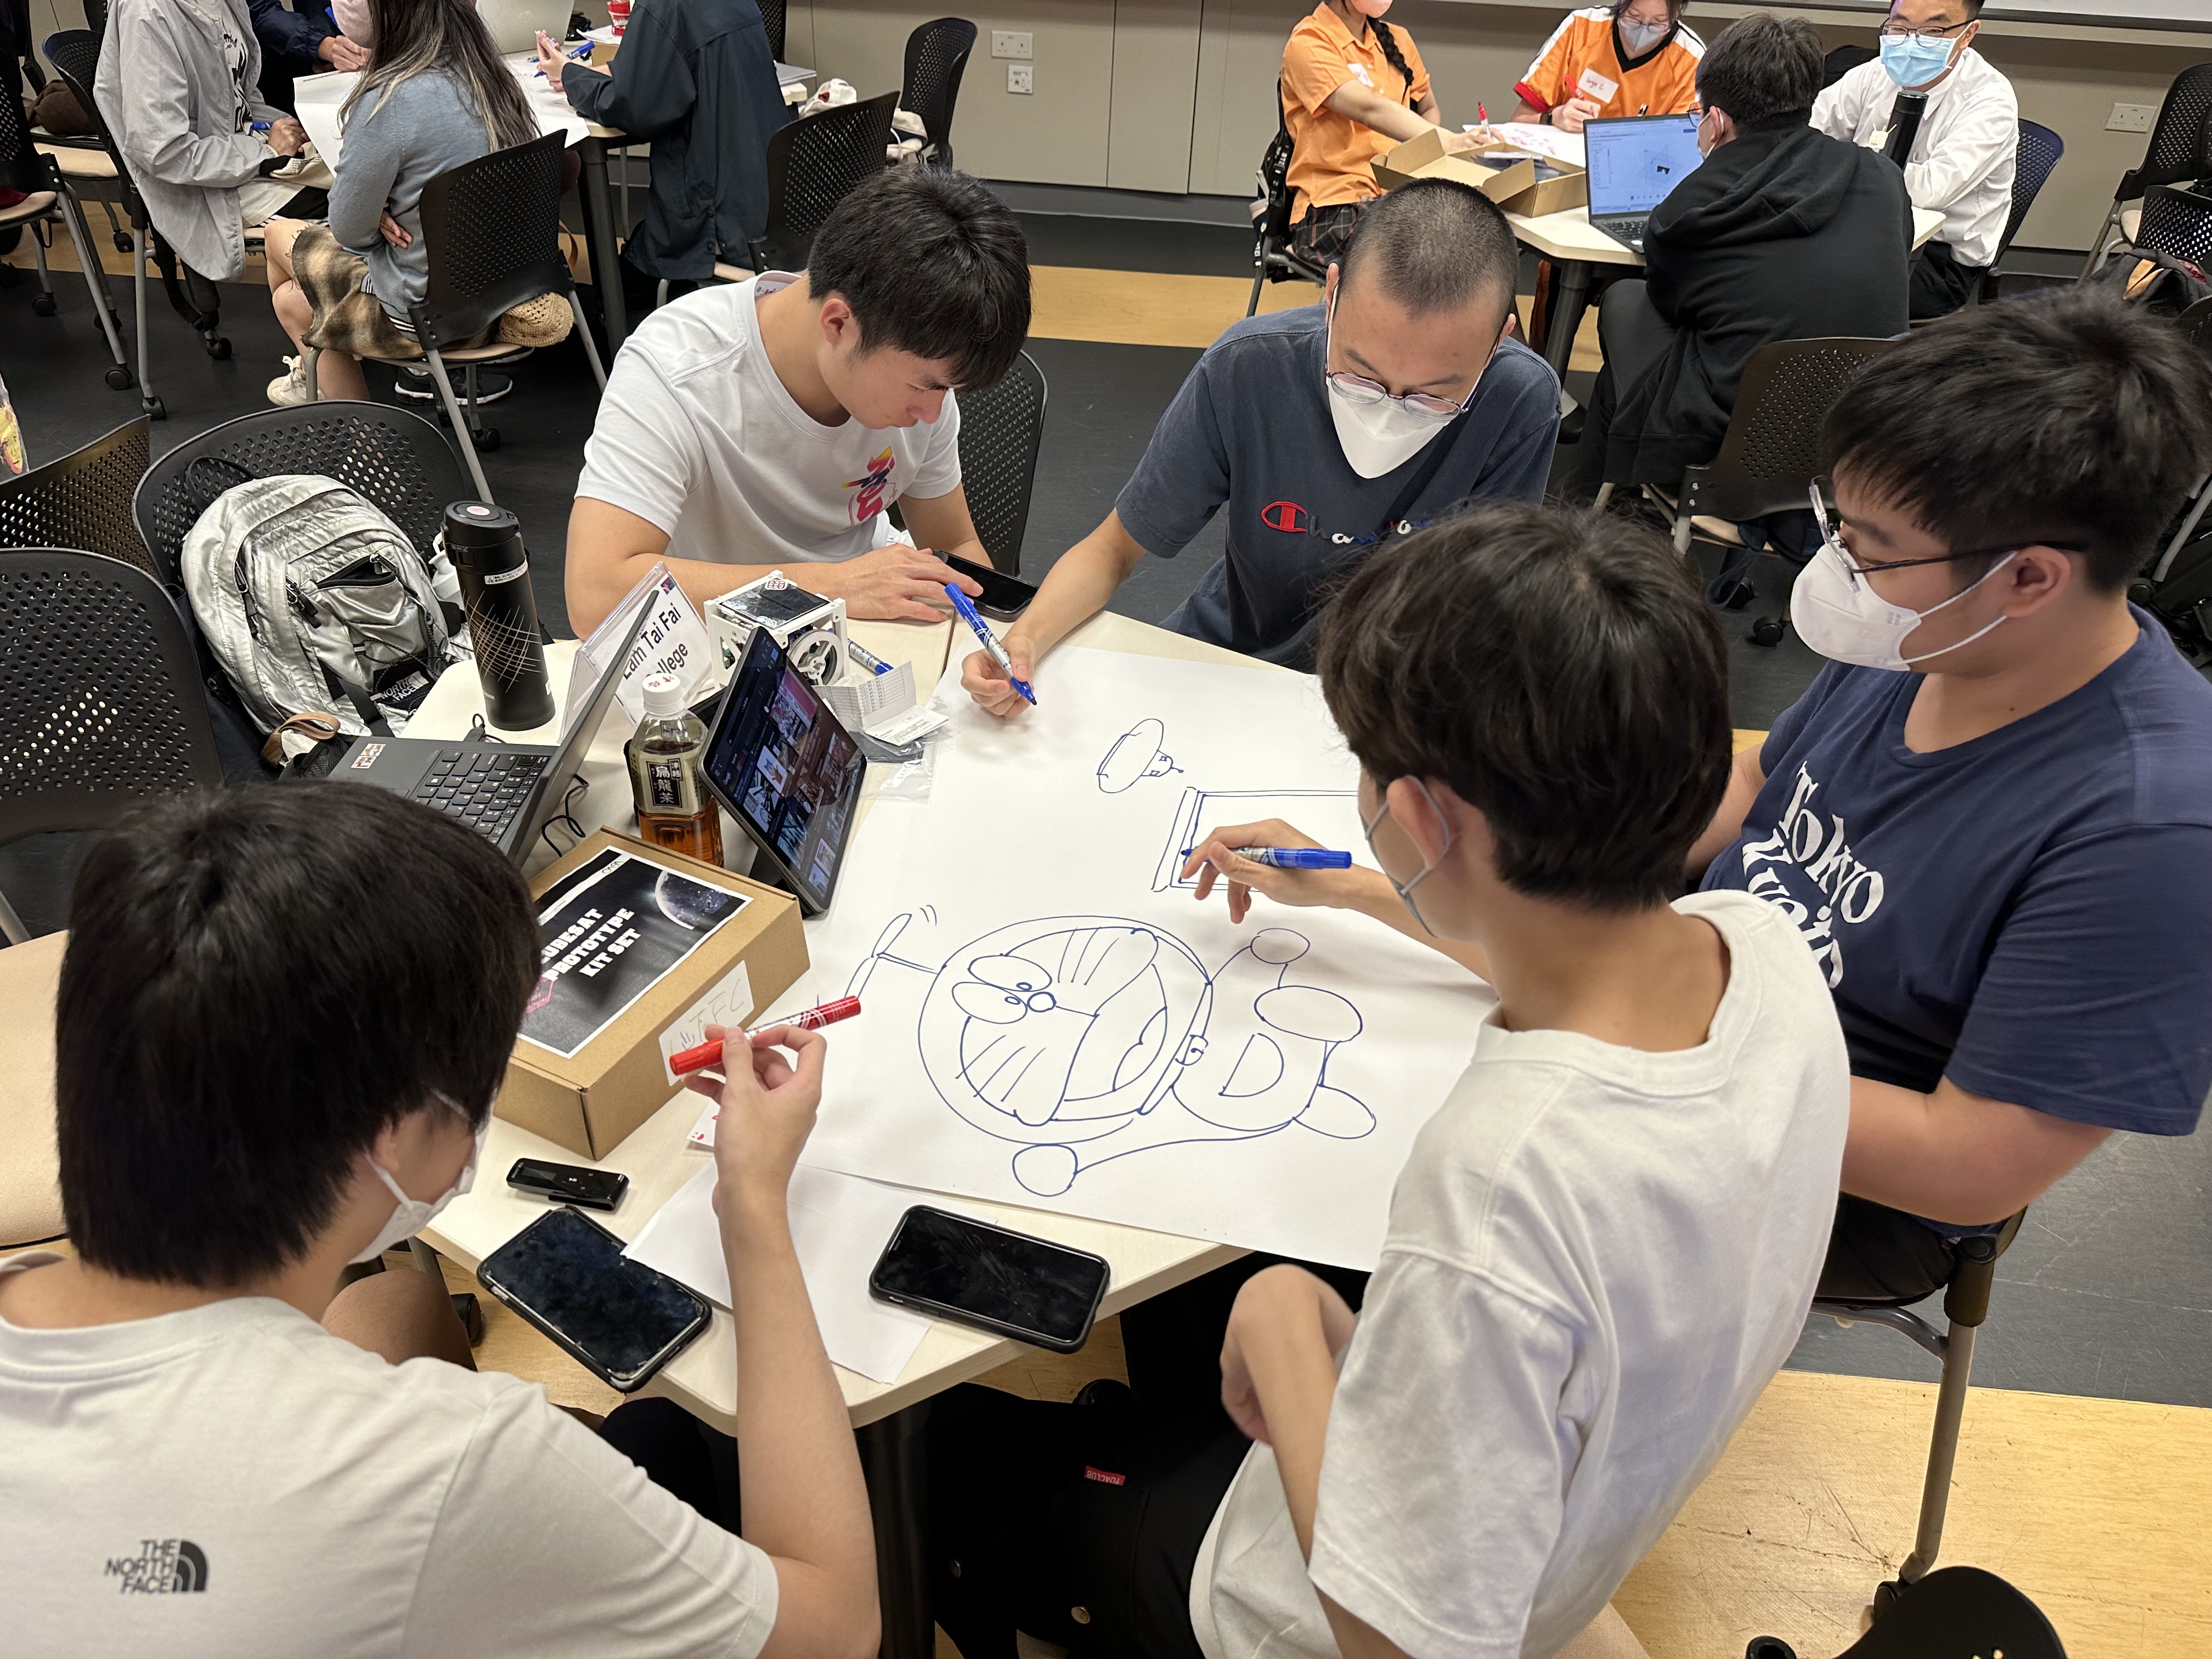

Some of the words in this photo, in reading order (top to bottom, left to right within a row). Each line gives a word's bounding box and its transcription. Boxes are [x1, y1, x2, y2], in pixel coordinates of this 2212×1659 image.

[640, 621, 664, 650] Tai
[658, 602, 682, 632] Fai
[646, 643, 689, 678] llege
[380, 678, 410, 699] NORTH
[392, 685, 417, 701] FACE
[656, 765, 675, 804] 烏龍茶
[541, 907, 635, 982] PROTOTYPE
[579, 951, 613, 977] KIT
[607, 928, 641, 955] SET
[140, 1539, 179, 1557] THE
[104, 1556, 173, 1576] NORTH
[120, 1575, 173, 1594] FACE
